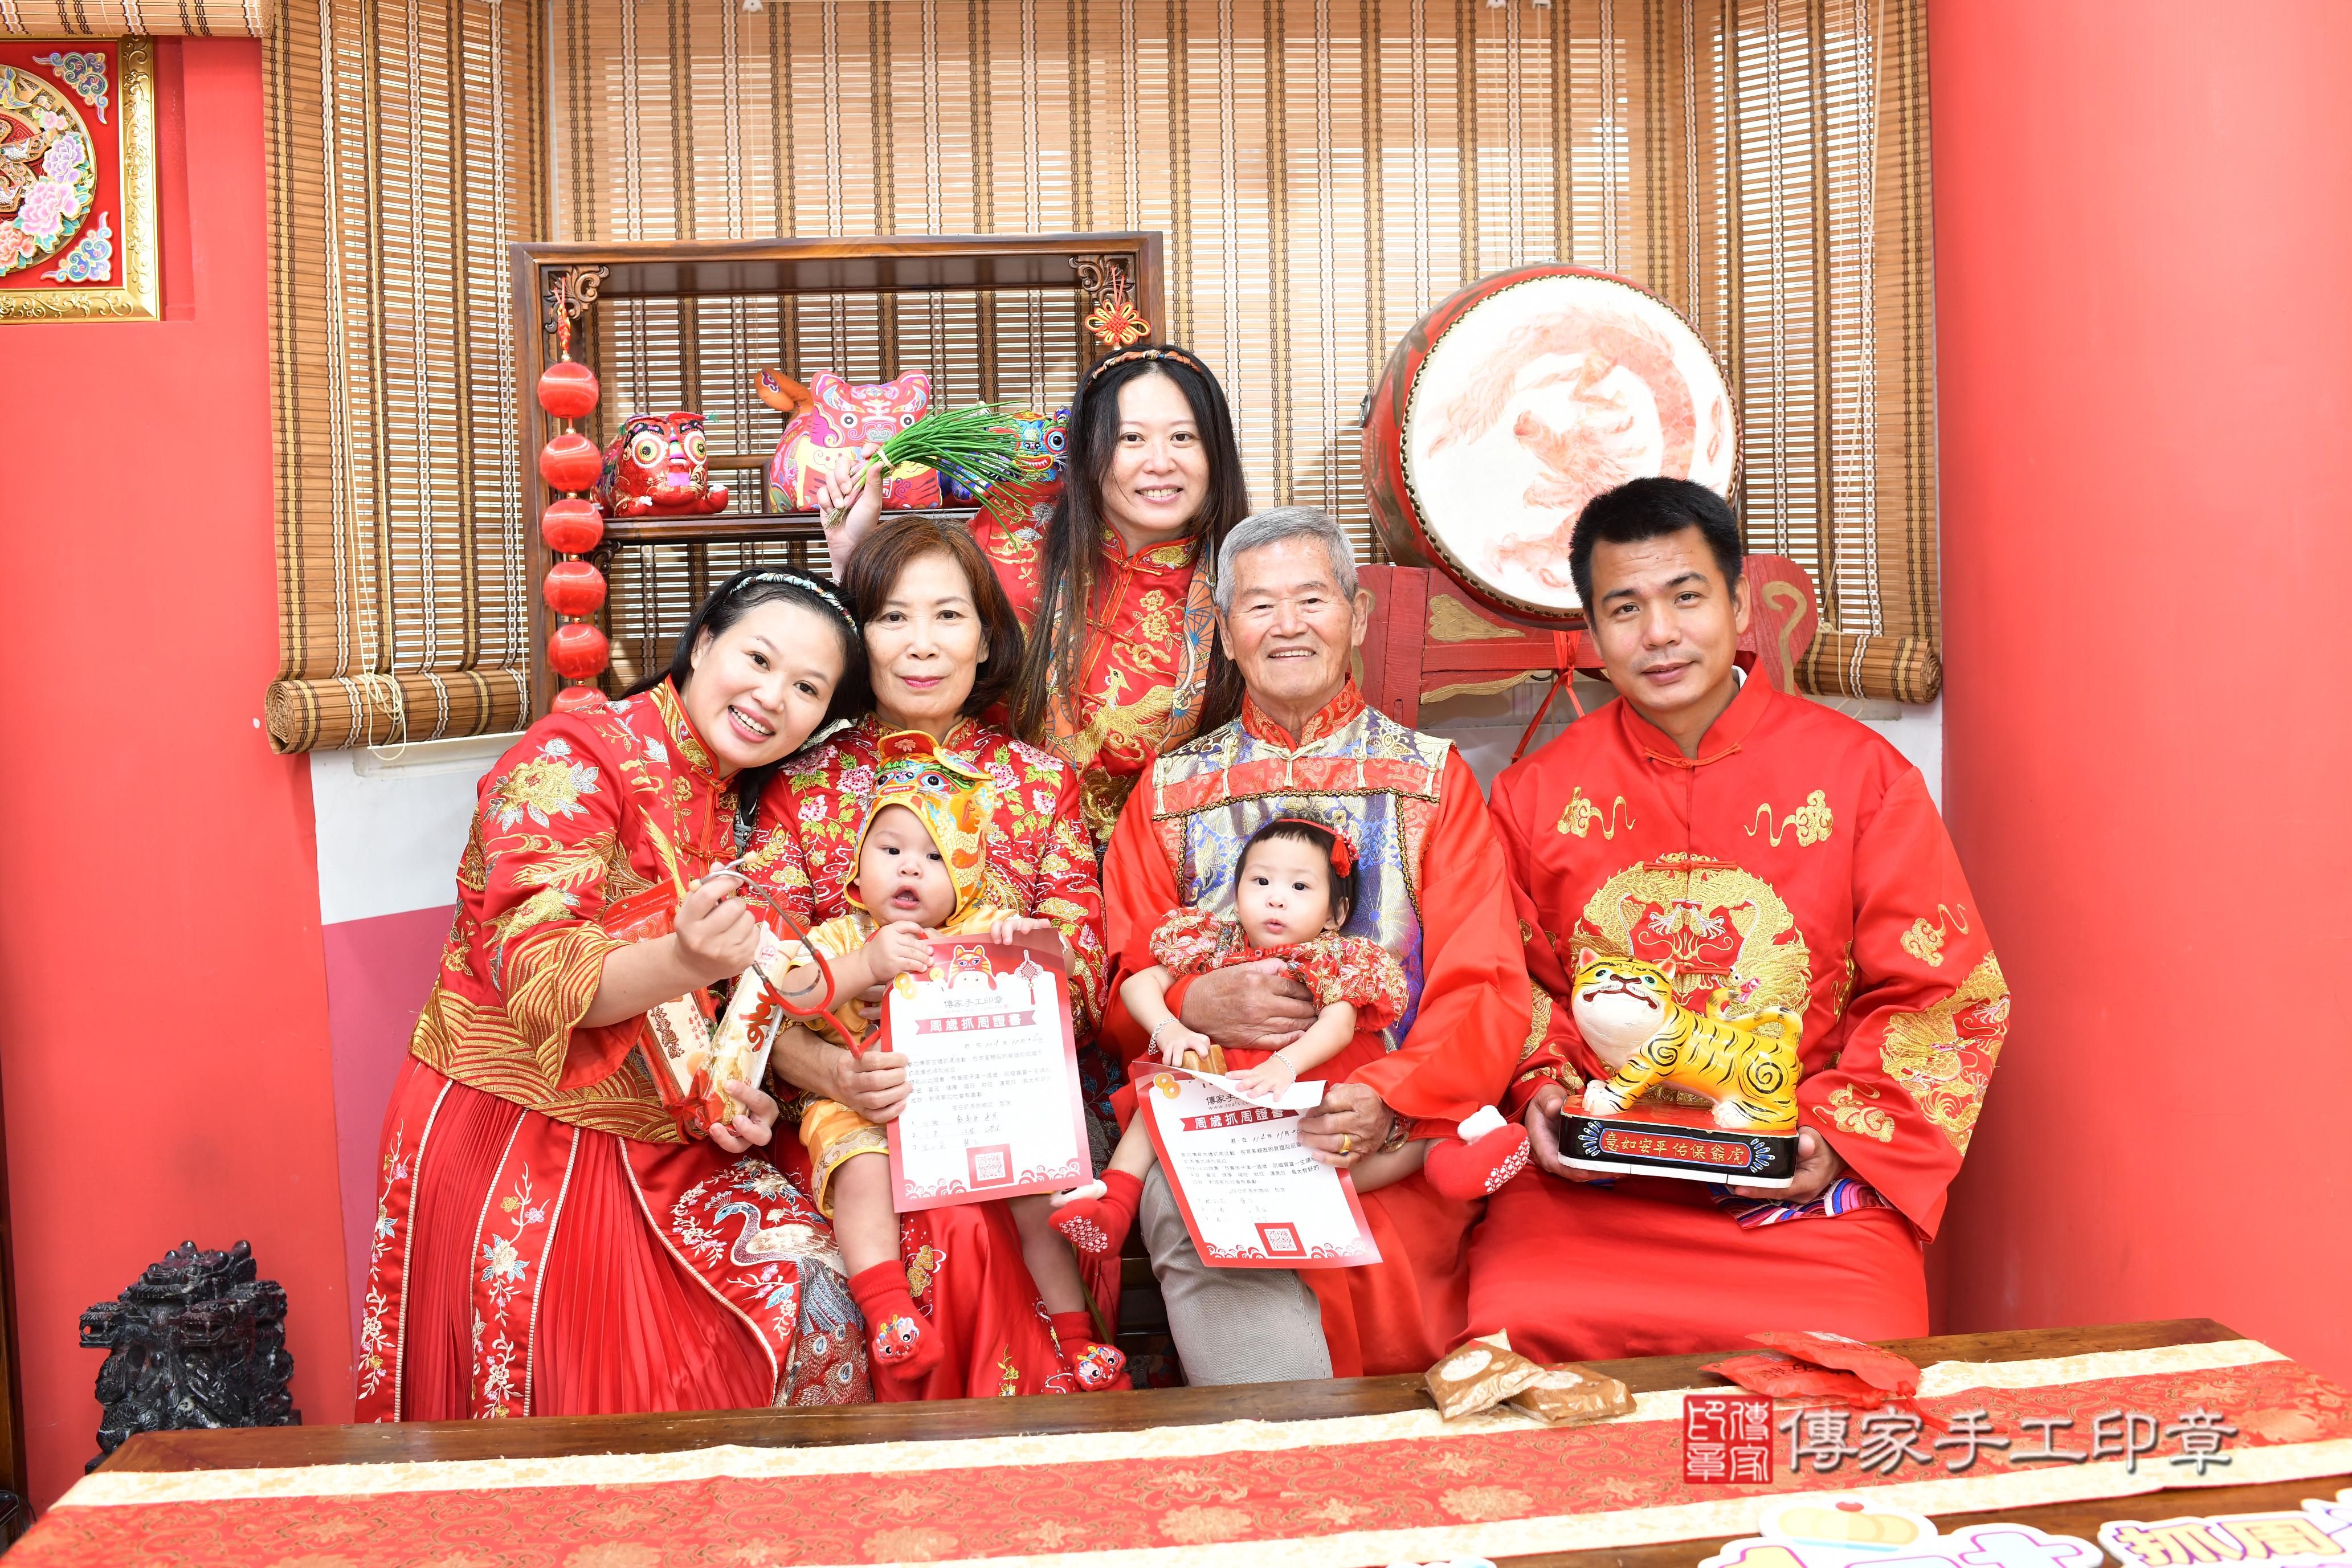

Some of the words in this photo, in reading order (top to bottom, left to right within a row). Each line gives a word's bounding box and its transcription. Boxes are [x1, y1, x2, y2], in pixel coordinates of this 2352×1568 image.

[944, 995, 1003, 1008] 傳家手工印章
[930, 1014, 1022, 1032] 周歲抓周證書
[1206, 1093, 1239, 1105] 傳家手
[1194, 1108, 1284, 1130] 周歲抓周證書
[2113, 1517, 2346, 1567] 抓周
